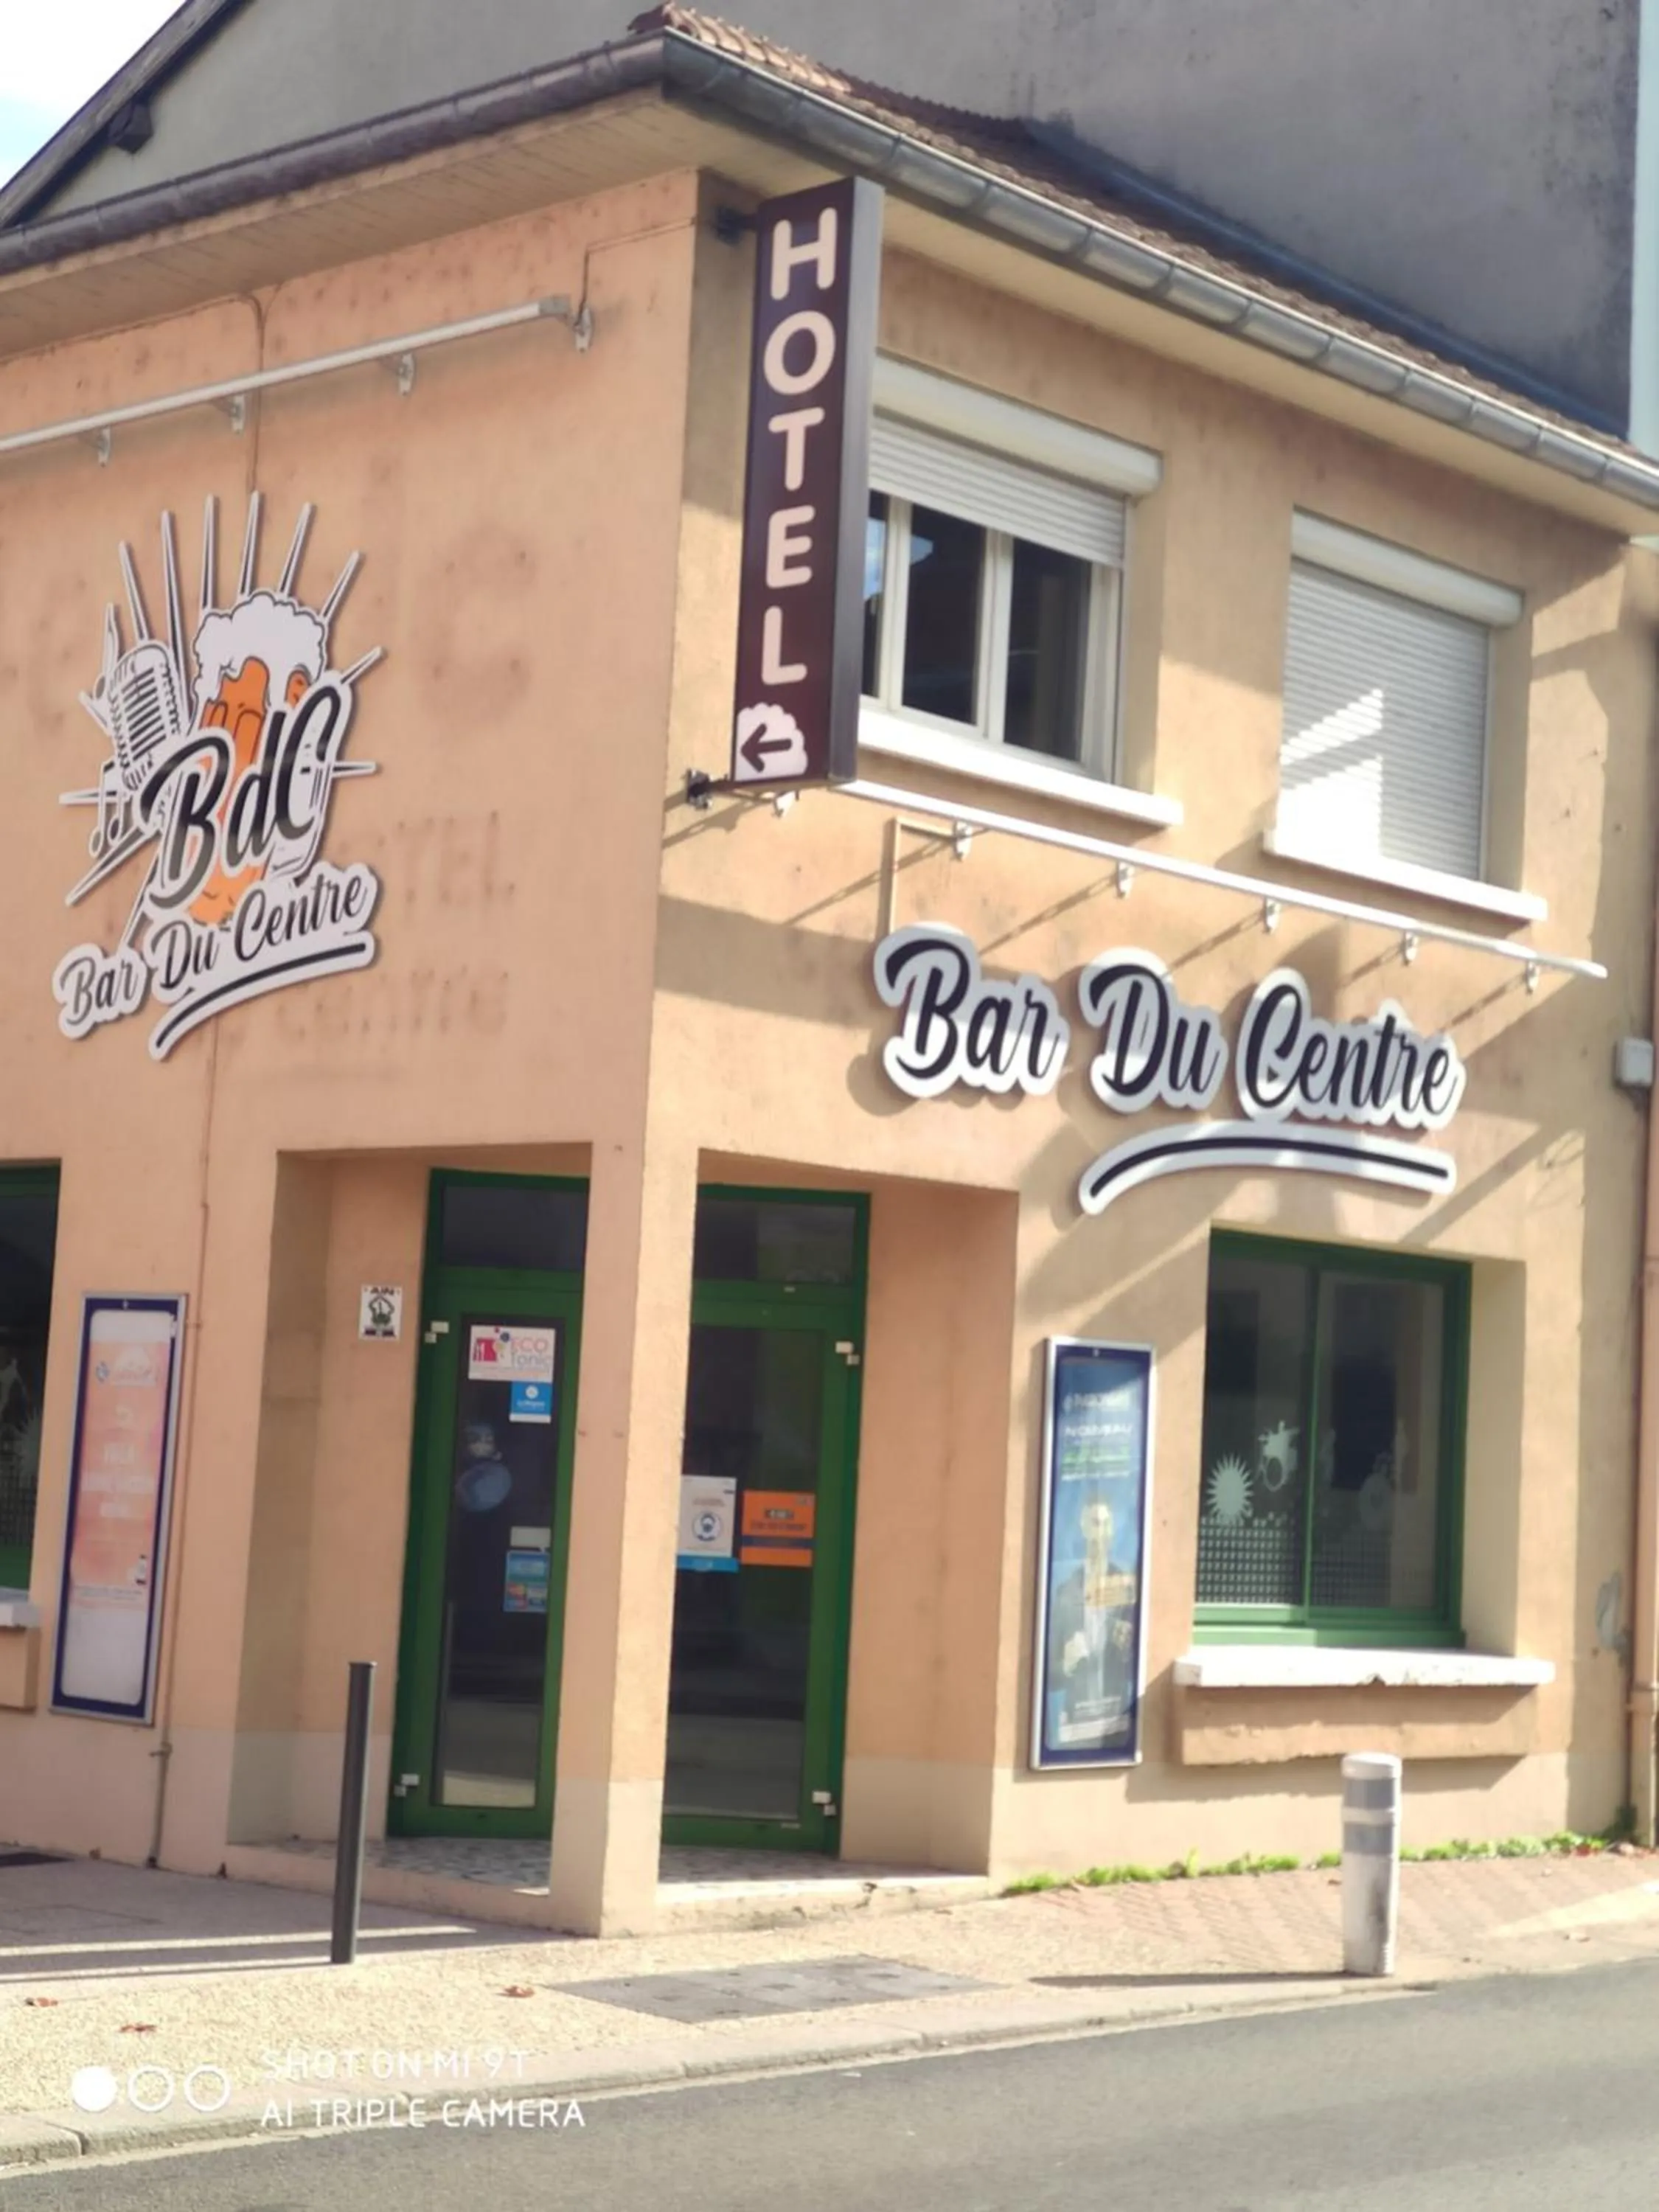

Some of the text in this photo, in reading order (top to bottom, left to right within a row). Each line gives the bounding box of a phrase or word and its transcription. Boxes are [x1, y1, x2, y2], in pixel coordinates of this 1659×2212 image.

[760, 207, 838, 686] HOTEL
[140, 686, 341, 908] BdC
[59, 873, 367, 1026] Bar Du Centre
[885, 938, 1458, 1116] Bar Du Centre
